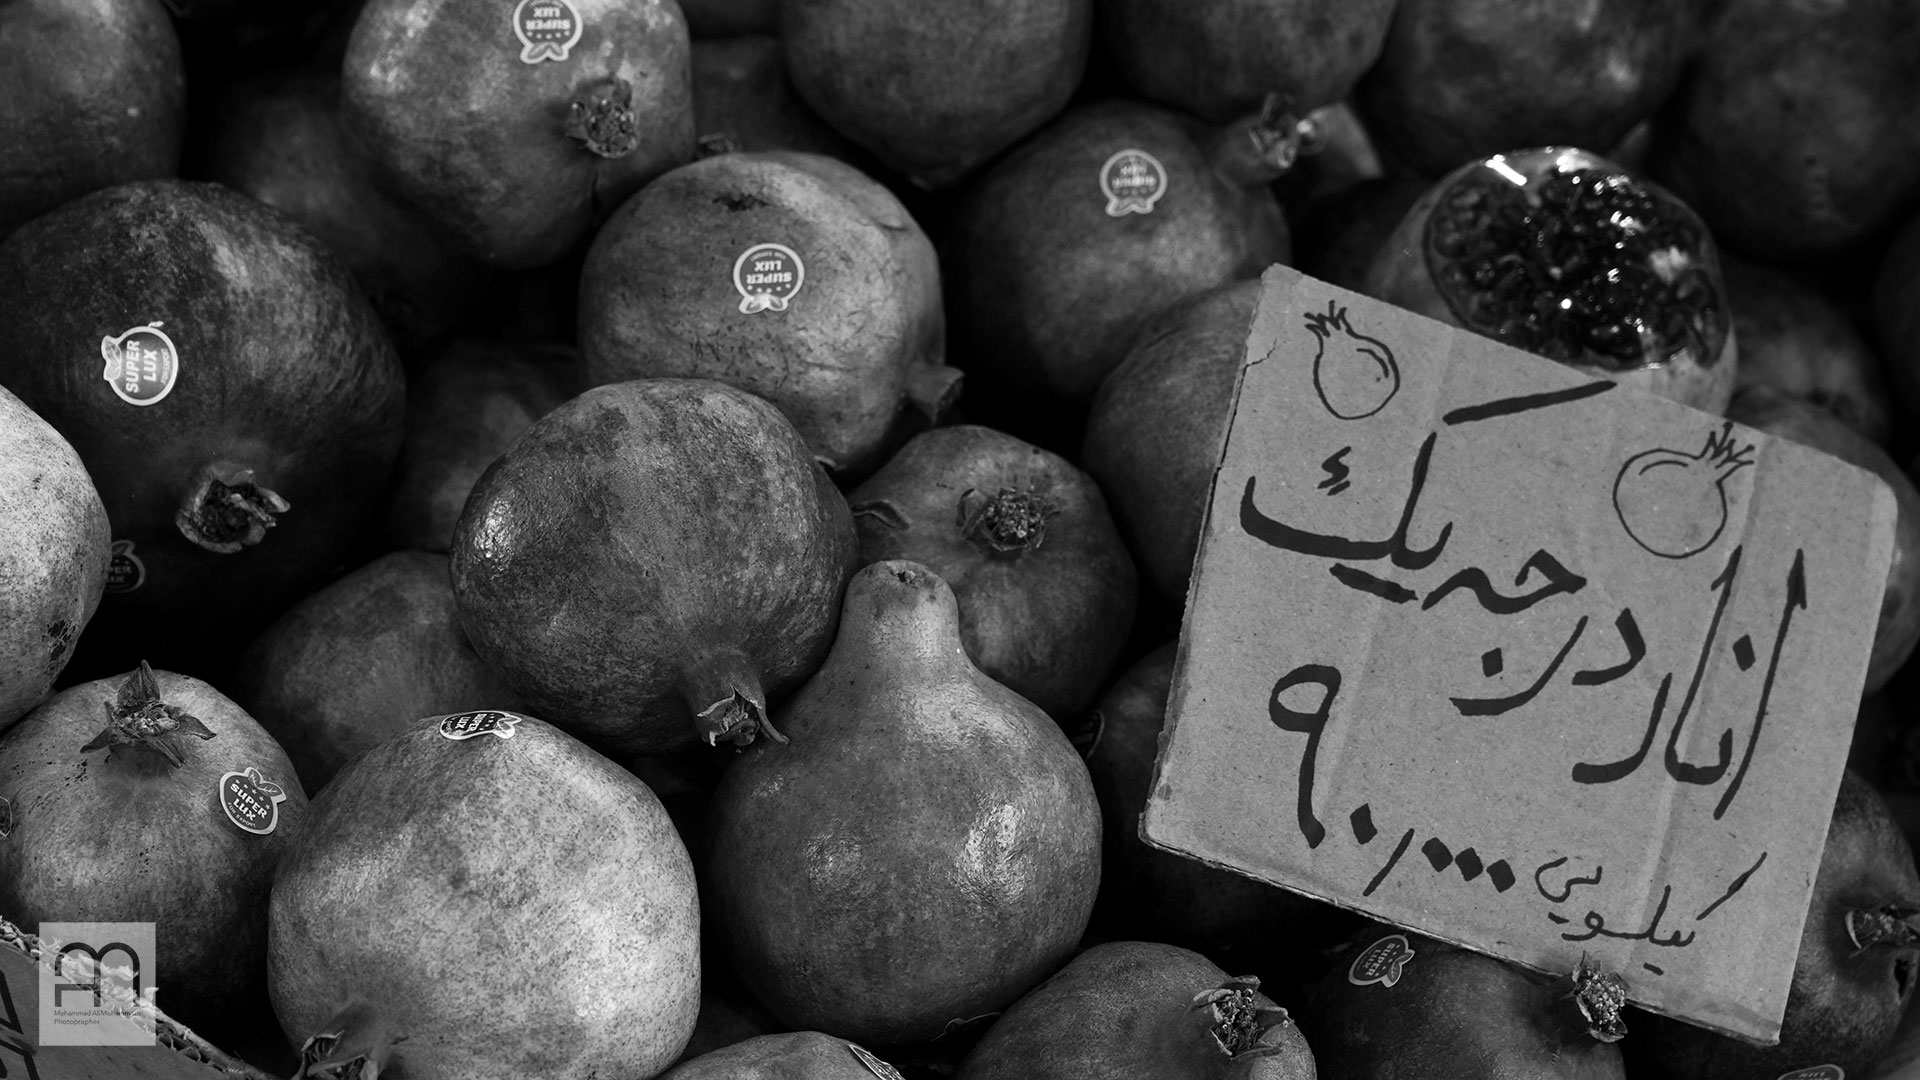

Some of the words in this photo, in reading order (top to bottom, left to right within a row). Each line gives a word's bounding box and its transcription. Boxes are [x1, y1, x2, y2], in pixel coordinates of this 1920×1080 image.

[533, 6, 561, 18] LUX
[525, 19, 571, 31] SUPER
[754, 260, 782, 272] LUX
[746, 271, 792, 284] SUPER
[125, 340, 140, 394] SUPER
[143, 349, 158, 382] LUX
[1571, 544, 1807, 821] انار
[227, 802, 236, 815] FOR
[230, 783, 268, 819] SUPER
[233, 798, 257, 821] LUX
[1361, 949, 1382, 969] LUX
[1365, 942, 1396, 976] SUPER
